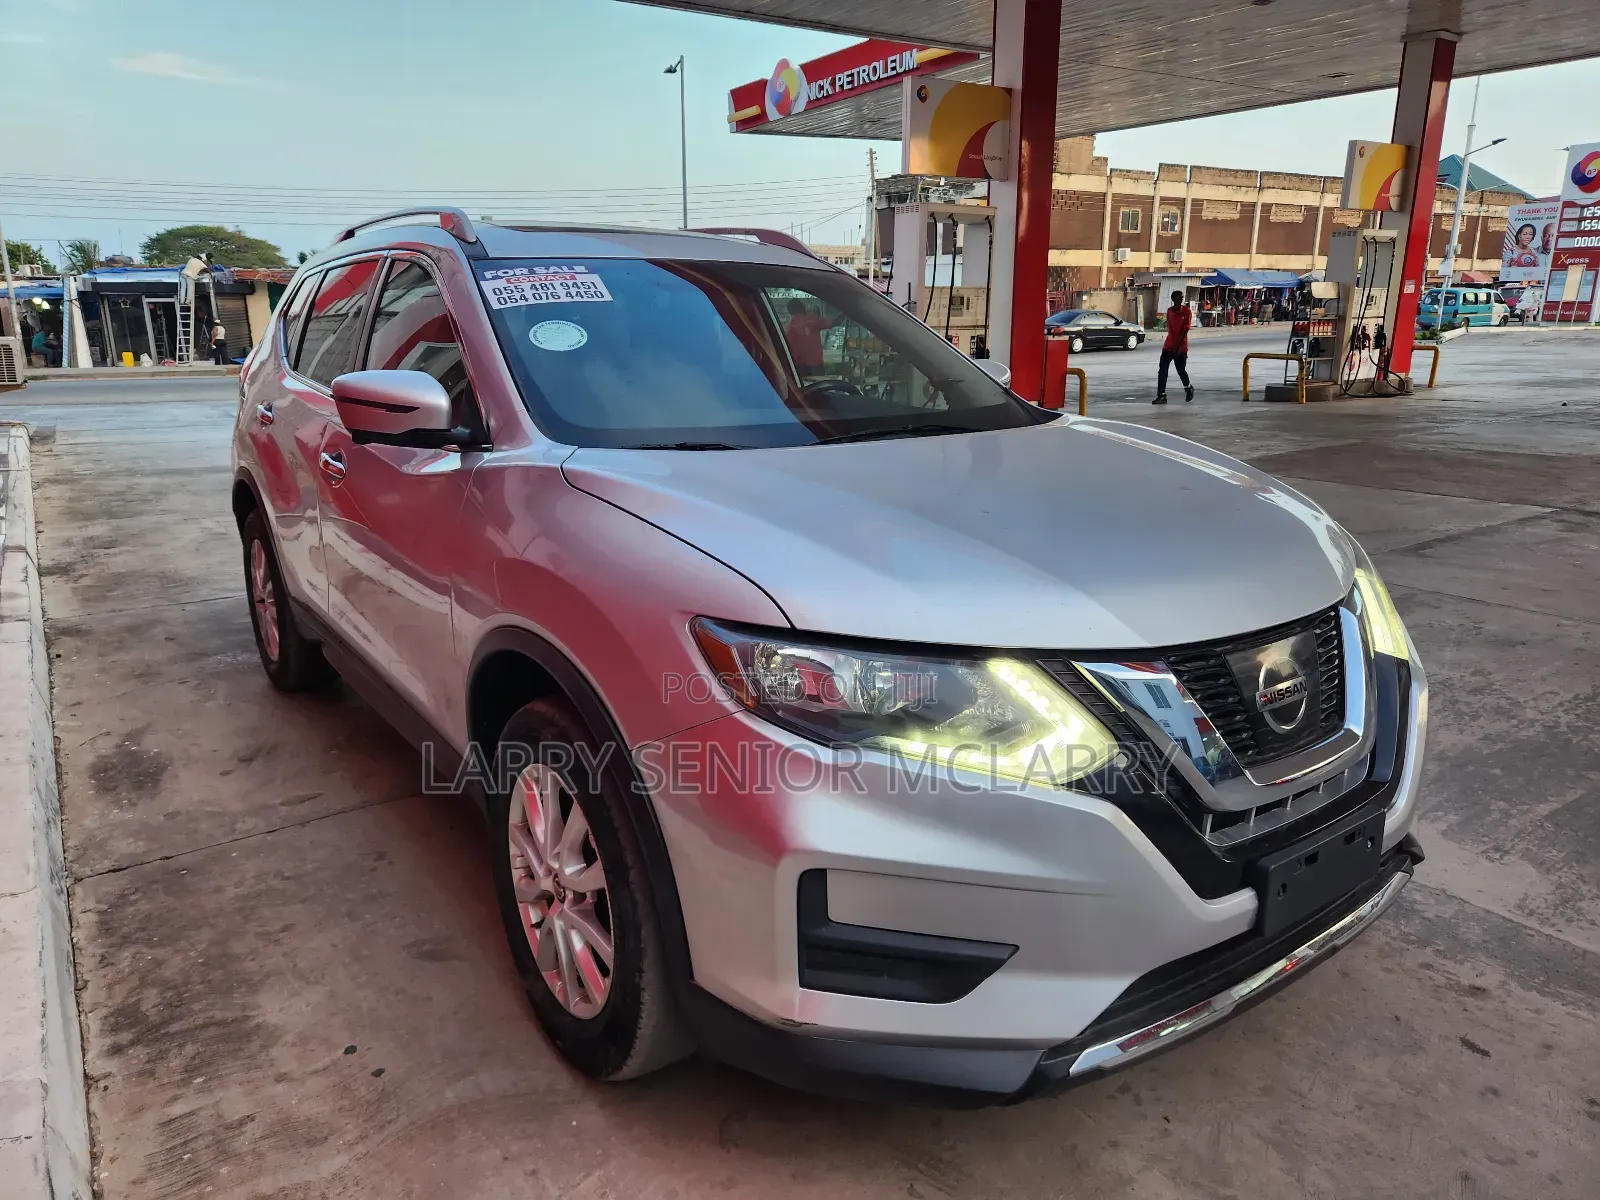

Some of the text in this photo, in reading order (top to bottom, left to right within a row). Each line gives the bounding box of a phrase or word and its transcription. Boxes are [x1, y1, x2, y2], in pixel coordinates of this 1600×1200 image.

[836, 48, 917, 92] PETROLEUM
[1517, 207, 1542, 215] THANK
[1557, 254, 1589, 265] Xpress
[484, 265, 588, 279] FOR SALE
[510, 275, 571, 283] CONTACT
[492, 281, 598, 296] 055 481 9451
[496, 290, 604, 305] 054 076 4450
[1263, 681, 1308, 706] NISSAN
